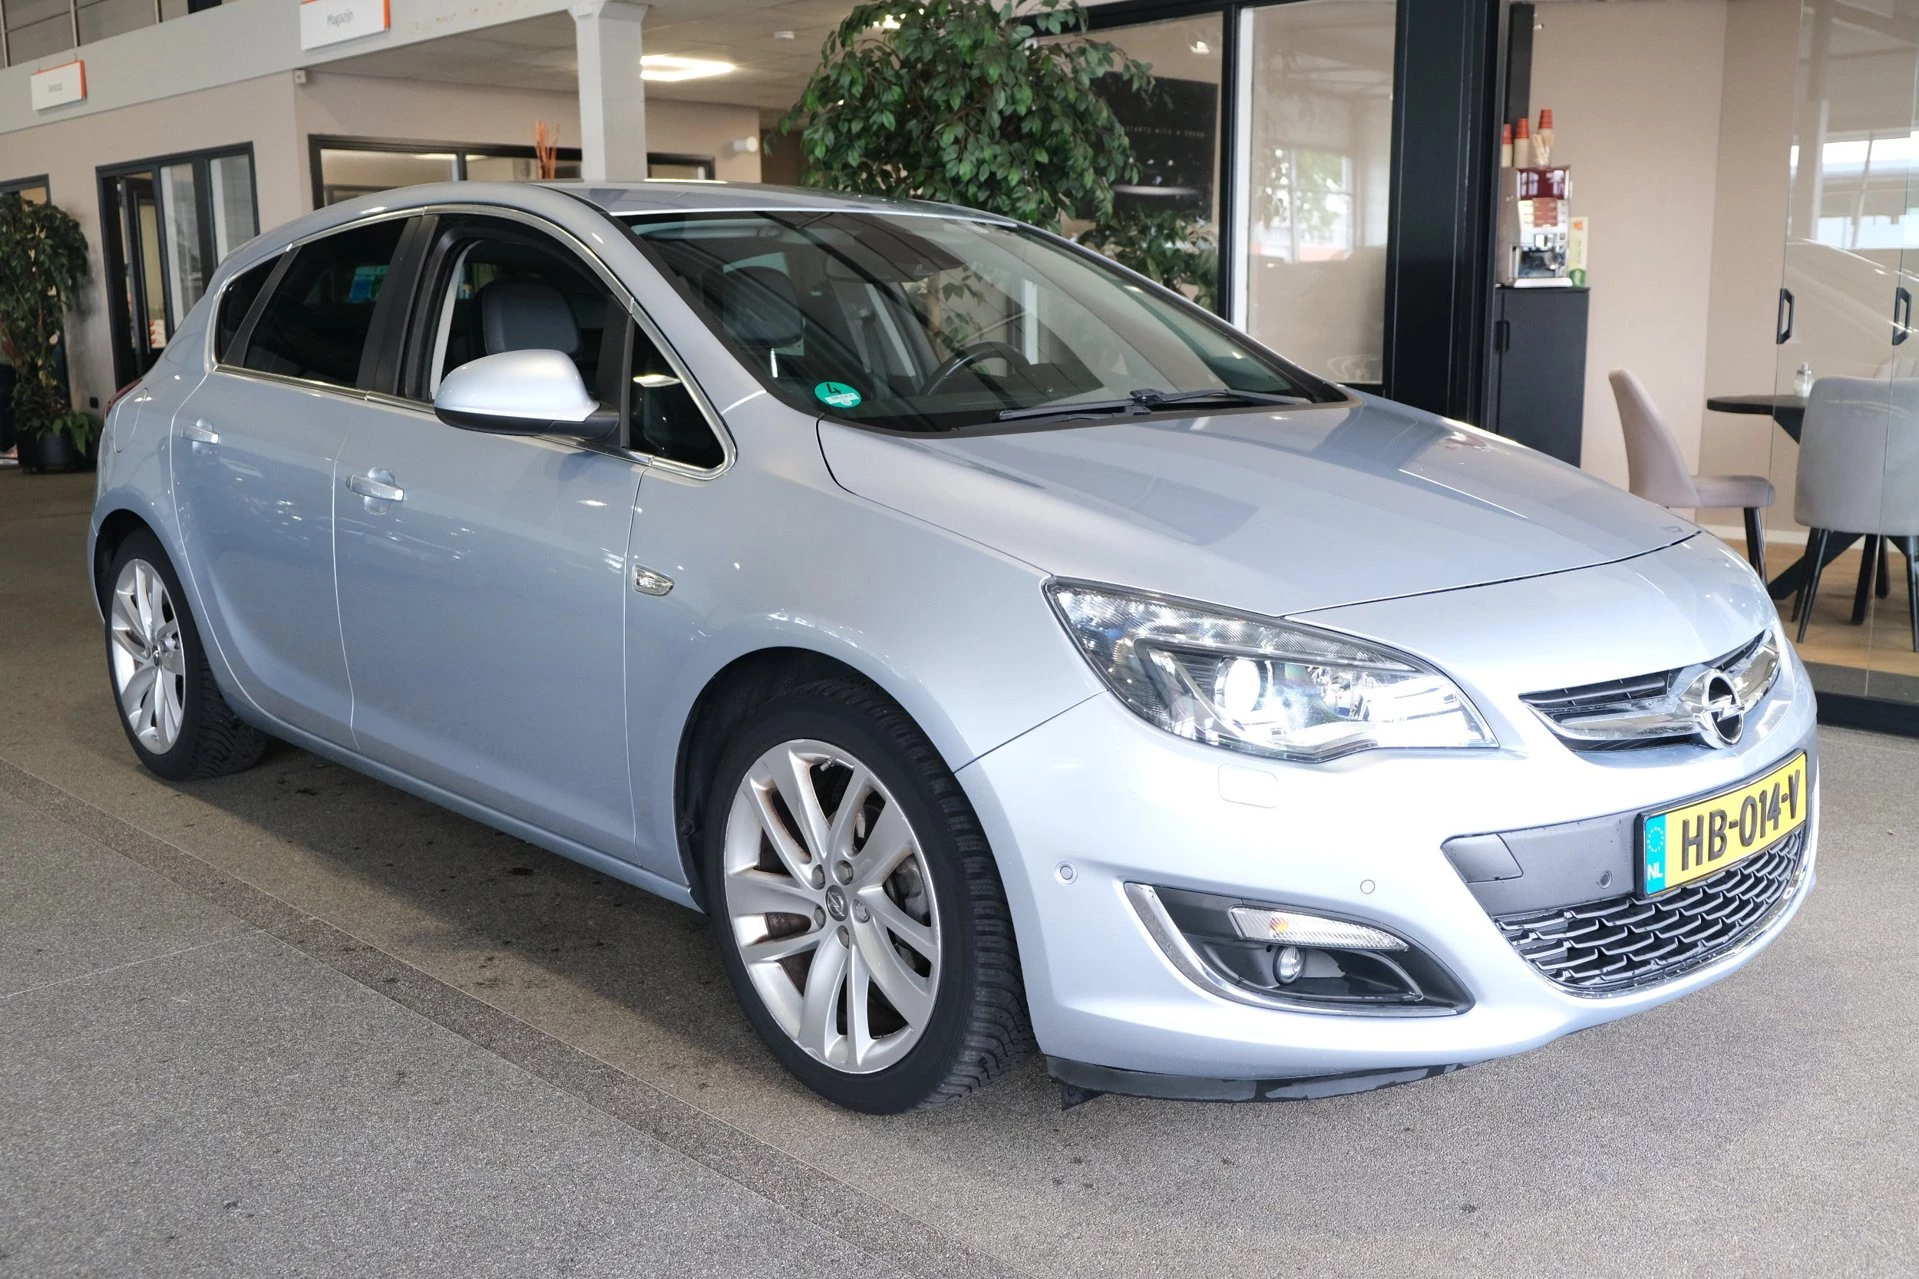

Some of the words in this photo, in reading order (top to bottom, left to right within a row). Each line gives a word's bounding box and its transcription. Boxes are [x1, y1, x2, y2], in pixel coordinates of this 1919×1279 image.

[826, 382, 842, 394] 4
[1681, 769, 1801, 871] HB-014-V
[1647, 861, 1663, 881] NL
